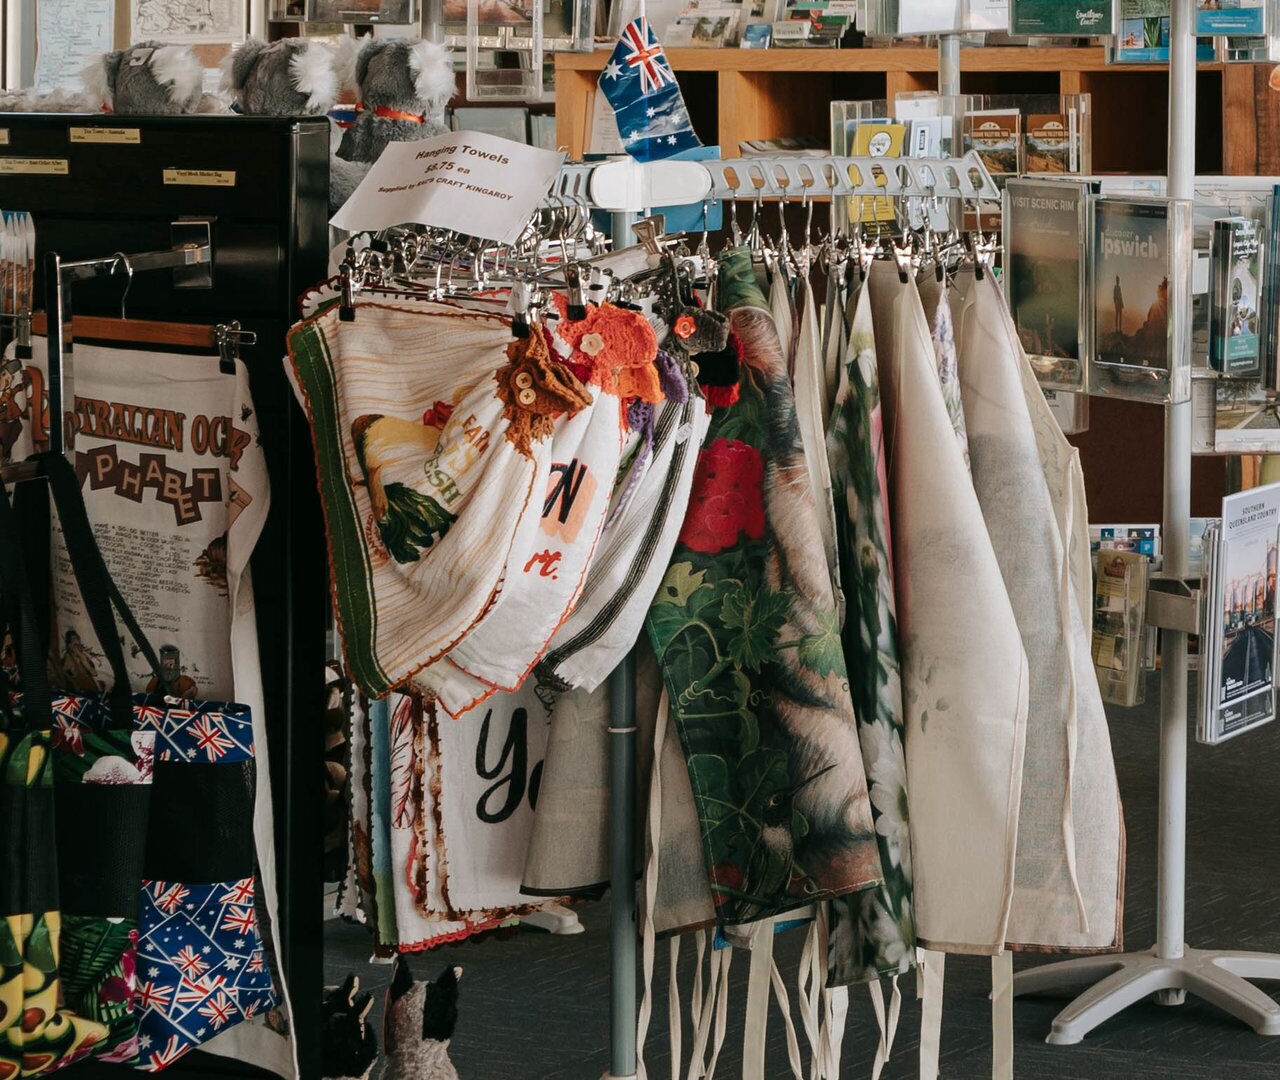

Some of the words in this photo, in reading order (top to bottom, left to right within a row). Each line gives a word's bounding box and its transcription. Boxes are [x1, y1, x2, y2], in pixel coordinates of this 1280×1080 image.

[415, 145, 457, 161] Hanging
[461, 145, 510, 165] Towels
[435, 177, 465, 189] CRAFT
[465, 183, 514, 201] KINGAROY
[1011, 196, 1030, 207] VISIT
[1031, 197, 1060, 210] SCENIC
[1060, 199, 1075, 211] RIM
[1101, 232, 1159, 260] Ipswich
